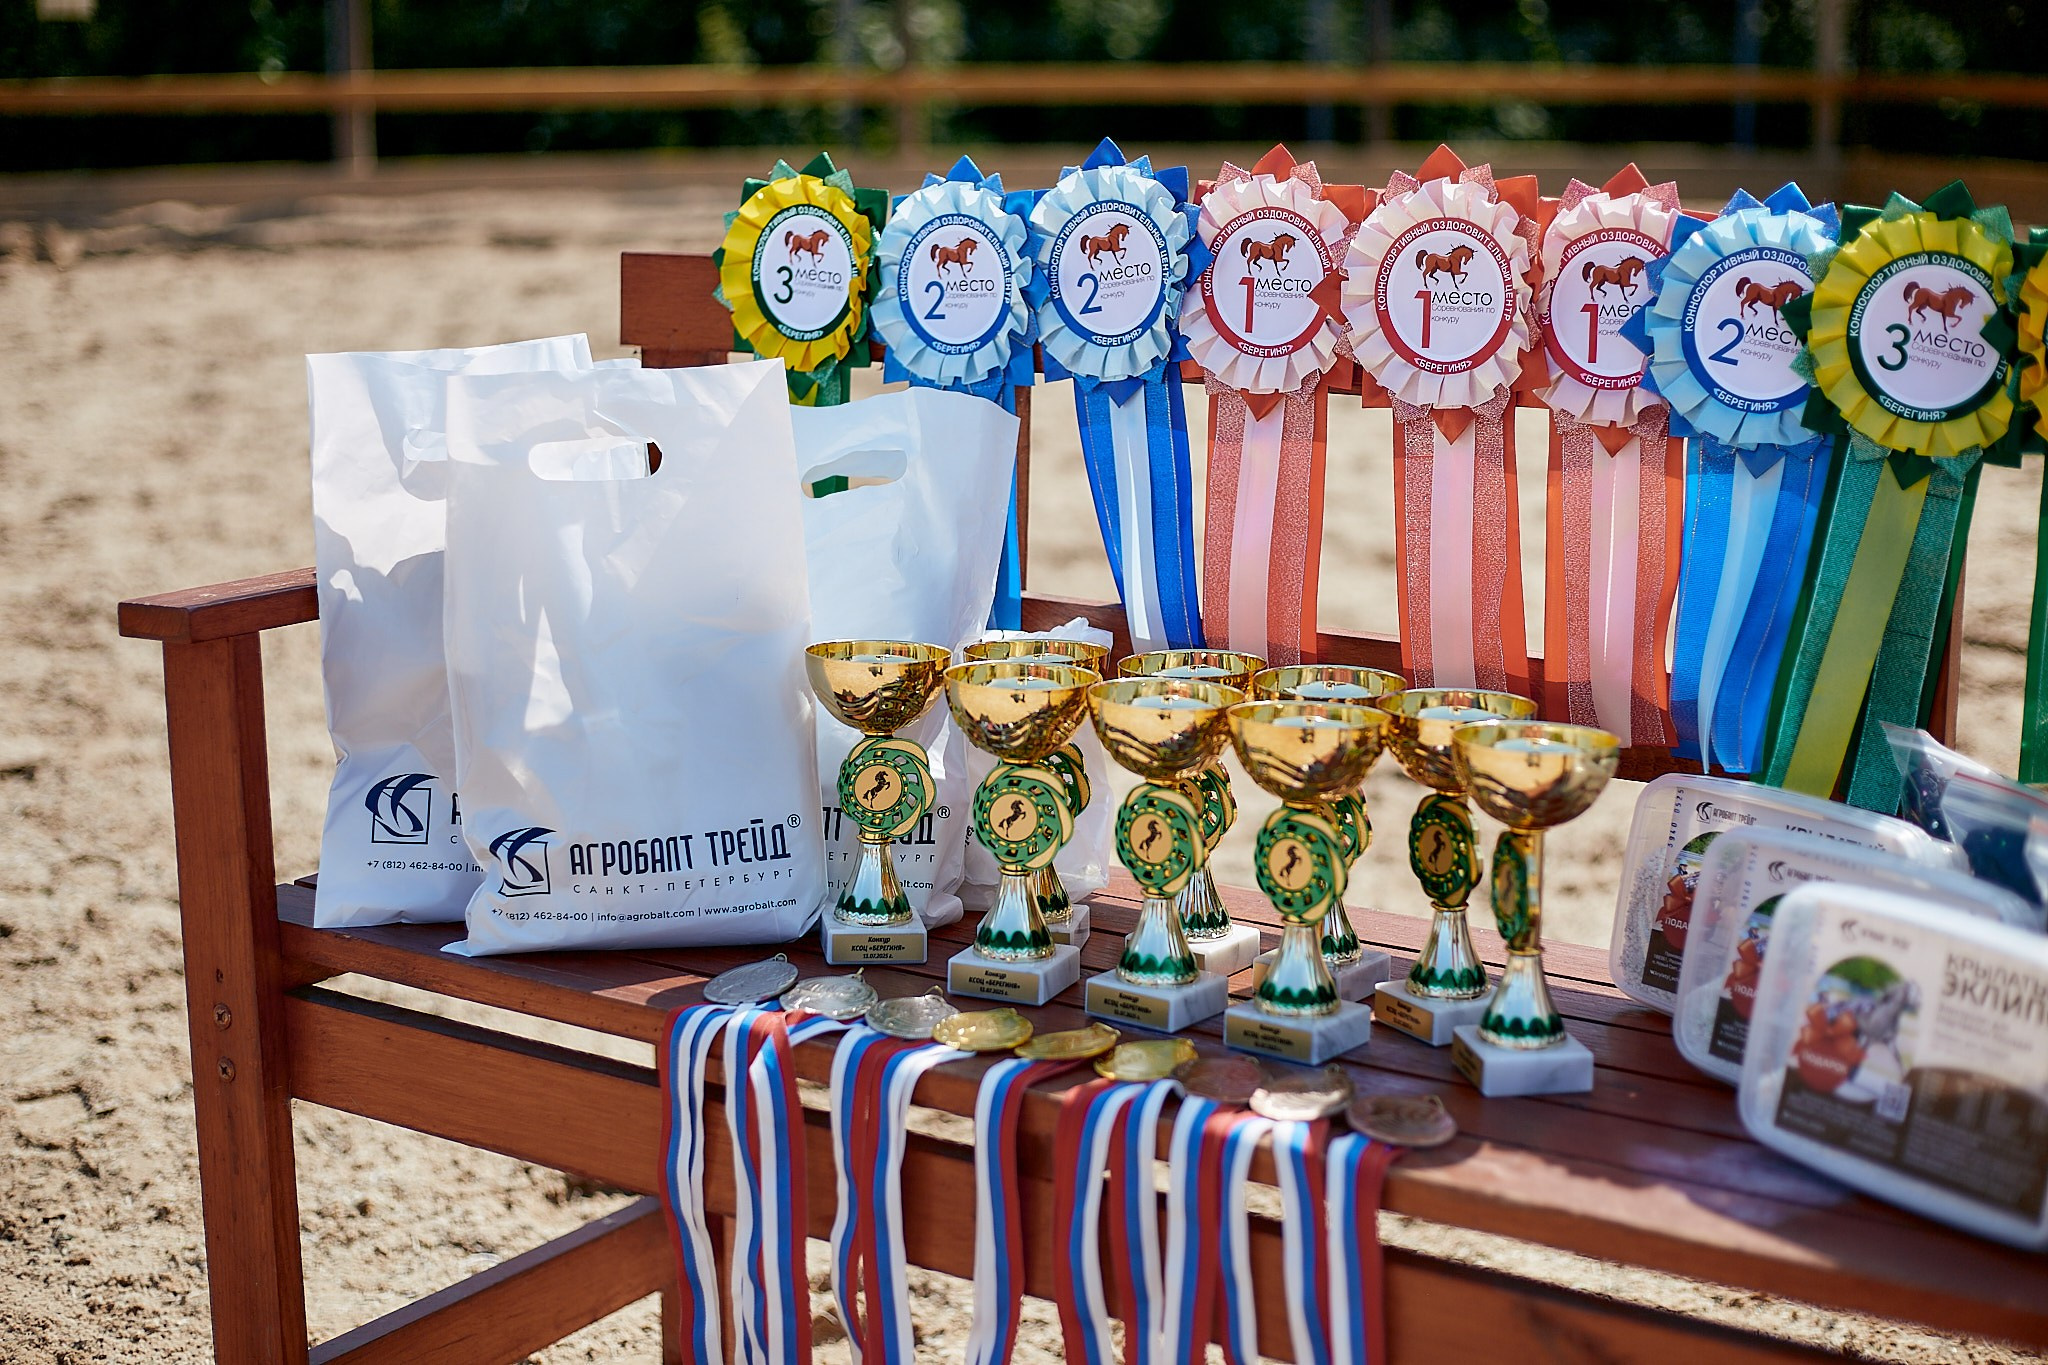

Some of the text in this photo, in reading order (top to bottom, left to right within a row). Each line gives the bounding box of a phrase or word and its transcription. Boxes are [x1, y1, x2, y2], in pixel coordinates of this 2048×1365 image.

[899, 219, 942, 302] КОННОСПОРТИВНЫЙ
[942, 215, 1010, 268] ОЗДОРОВИТЕЛЬНЫЙ
[1050, 210, 1090, 300] КОННОСПОРТИВНЫЙ
[1090, 202, 1165, 249] ОЗДОРОВИТЕЛЬНЫЙ
[1256, 210, 1331, 270] ОЗДОРОВИТЕЛЬНЫЙ
[774, 266, 793, 304] 3
[795, 268, 842, 284] место
[1077, 262, 1151, 315] 2 место
[1377, 220, 1514, 321] КОННОСПОРТИВНЫЙ ОЗДОРОВИТЕЛЬНЫЙ ЦЕНТР
[1684, 248, 1760, 332] КОННОСПОРТИВНЫЙ
[1850, 253, 1929, 336] КОННОСПОРТИВНЫЙ
[924, 280, 995, 320] 2 место
[1238, 277, 1312, 334] 1 место
[1414, 290, 1493, 348] 1 место
[1432, 303, 1484, 313] Соревнования
[1432, 316, 1460, 324] конкуру
[1580, 304, 1598, 364] 1
[1708, 318, 1745, 366] 2
[1877, 323, 1986, 372] 3 место
[367, 860, 380, 868] +7
[382, 860, 406, 870] (812)
[409, 862, 462, 872] 462-84-00
[570, 834, 694, 876] АГРОБАЛТ
[573, 868, 793, 895] САНКТ-ПЕТЕРБУРГ
[506, 912, 530, 920] (812)
[534, 912, 588, 920] 462-84-00
[597, 908, 694, 922] info@agrobalt.com
[704, 898, 797, 915] www.agrobalt.com
